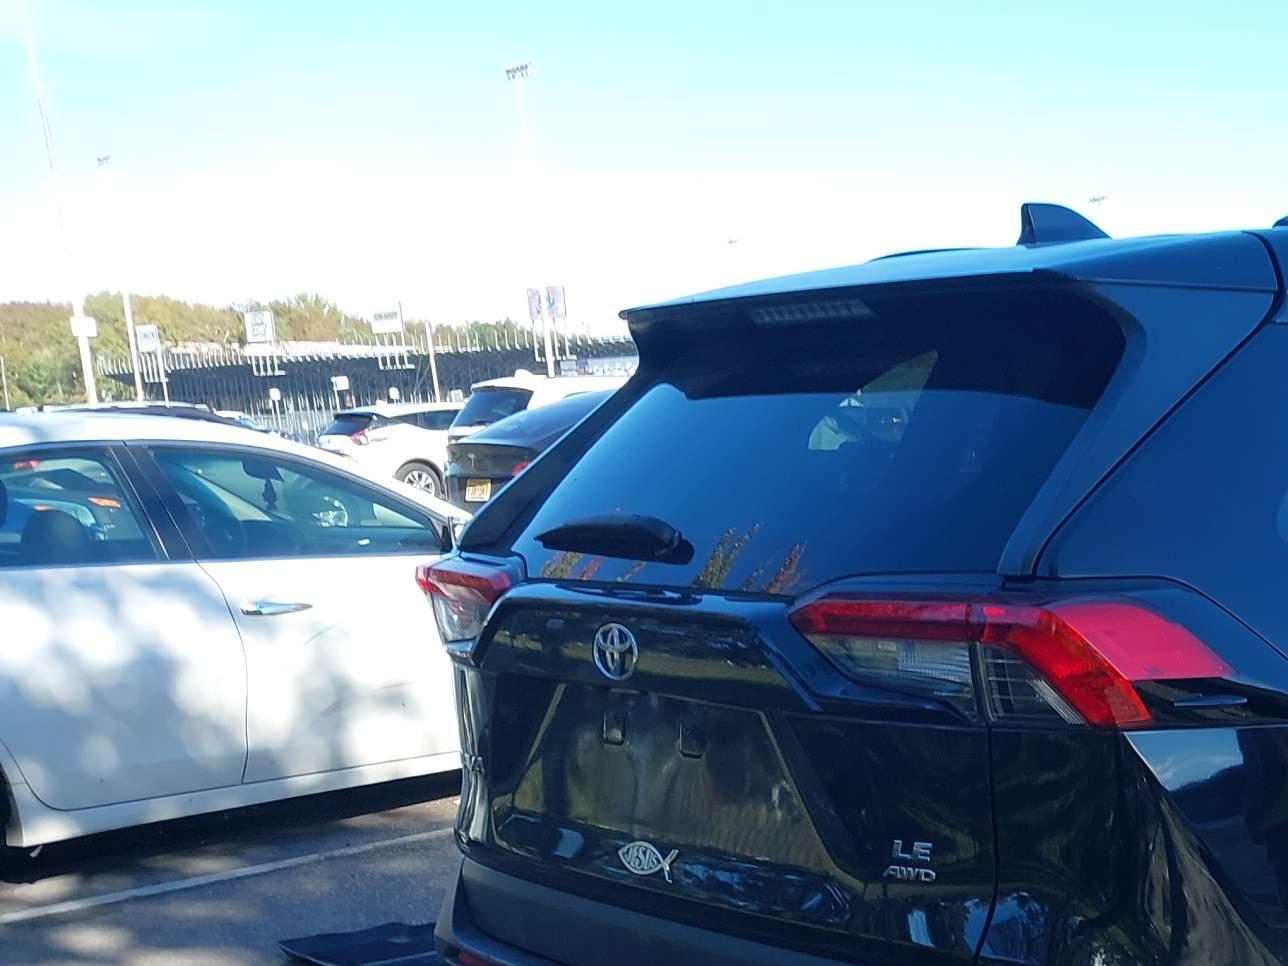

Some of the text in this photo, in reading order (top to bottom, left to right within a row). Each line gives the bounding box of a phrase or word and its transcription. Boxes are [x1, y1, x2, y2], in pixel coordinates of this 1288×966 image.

[623, 846, 657, 870] JESUS
[892, 840, 933, 862] LE
[882, 865, 936, 881] AWD
